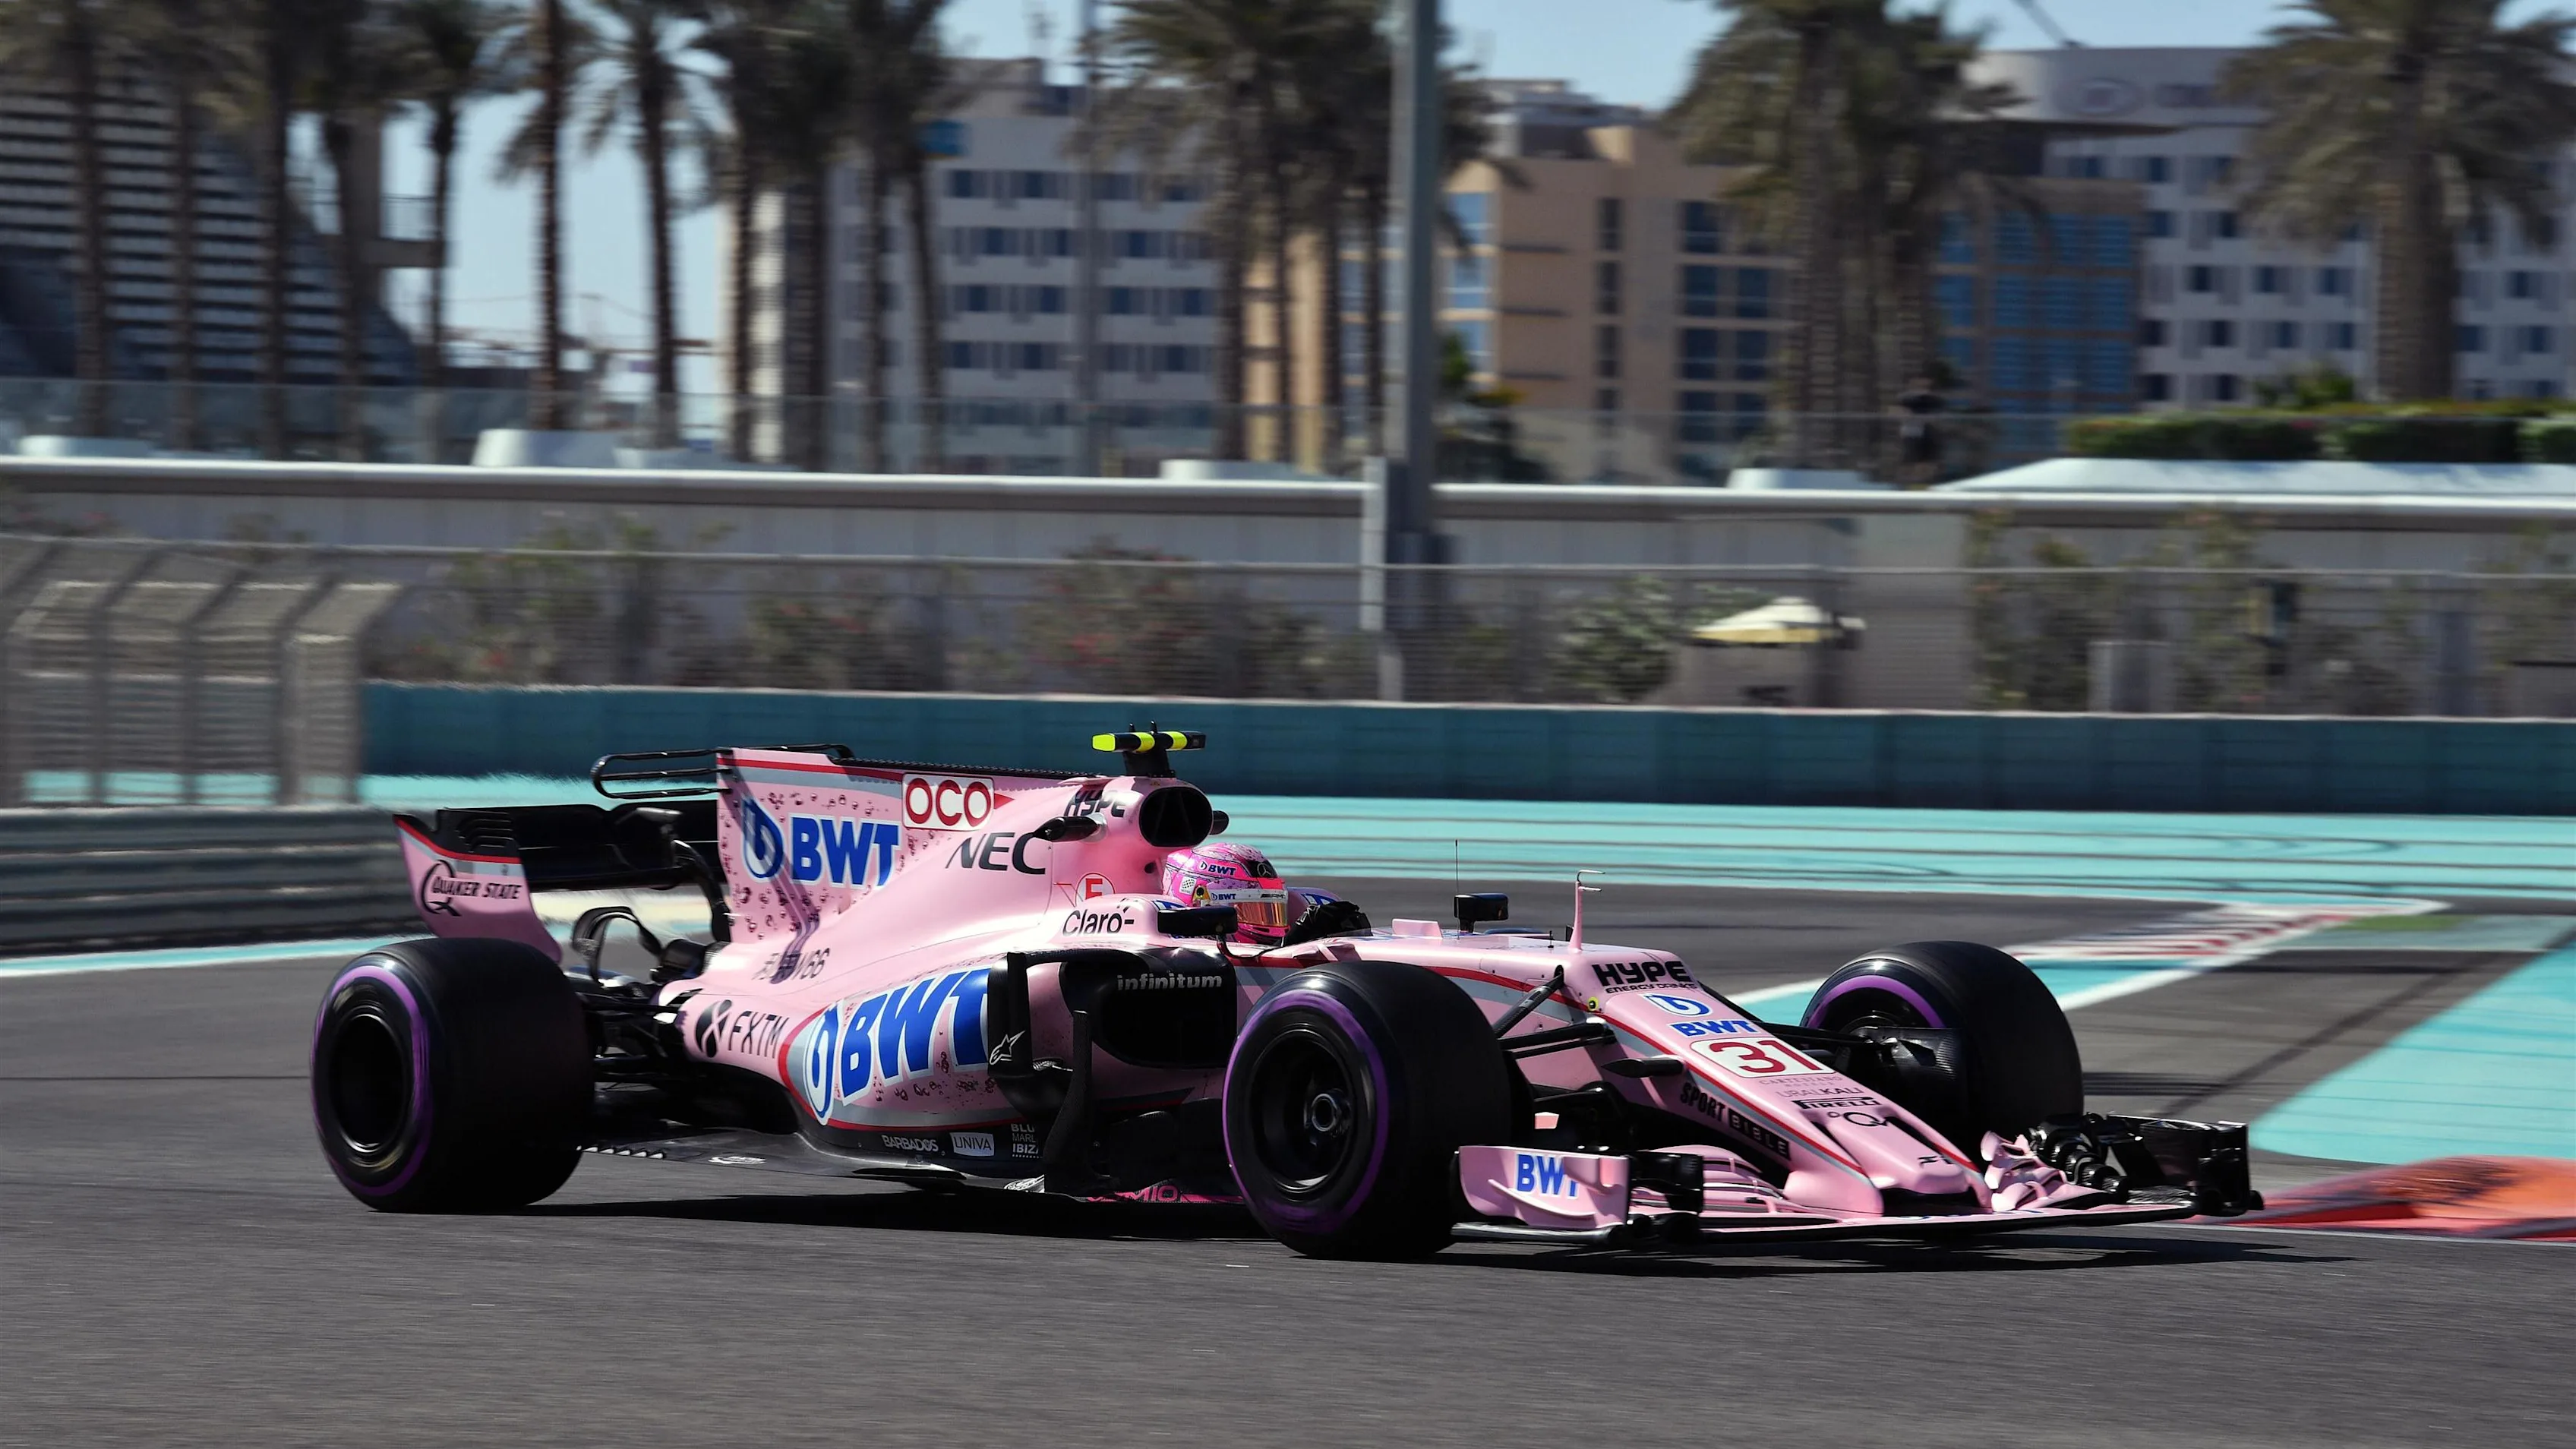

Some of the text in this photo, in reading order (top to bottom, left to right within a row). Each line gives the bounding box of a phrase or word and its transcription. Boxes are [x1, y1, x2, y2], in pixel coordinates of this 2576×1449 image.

[905, 777, 992, 826] OCO
[790, 815, 900, 886] BWT
[945, 832, 1046, 875] NEC
[1208, 864, 1236, 876] BWT
[431, 876, 522, 899] QUAKER STATE
[1062, 909, 1122, 936] Claro
[1117, 970, 1222, 990] infinitum
[1592, 961, 1693, 987] HYPE
[1605, 984, 1653, 993] ENERGY
[728, 1010, 789, 1058] FXTM
[841, 968, 990, 1100] BWT
[1672, 1021, 1757, 1037] BWT
[1709, 1040, 1823, 1073] 31
[1776, 1087, 1864, 1097] URALKALI
[1792, 1097, 1882, 1110] PIRELLI
[1011, 1123, 1035, 1132] BLU
[1680, 1081, 1787, 1155] SPORT BIBLE
[882, 1135, 939, 1152] BARBADOS
[955, 1137, 993, 1151] UNIVA
[1012, 1132, 1037, 1142] MARL
